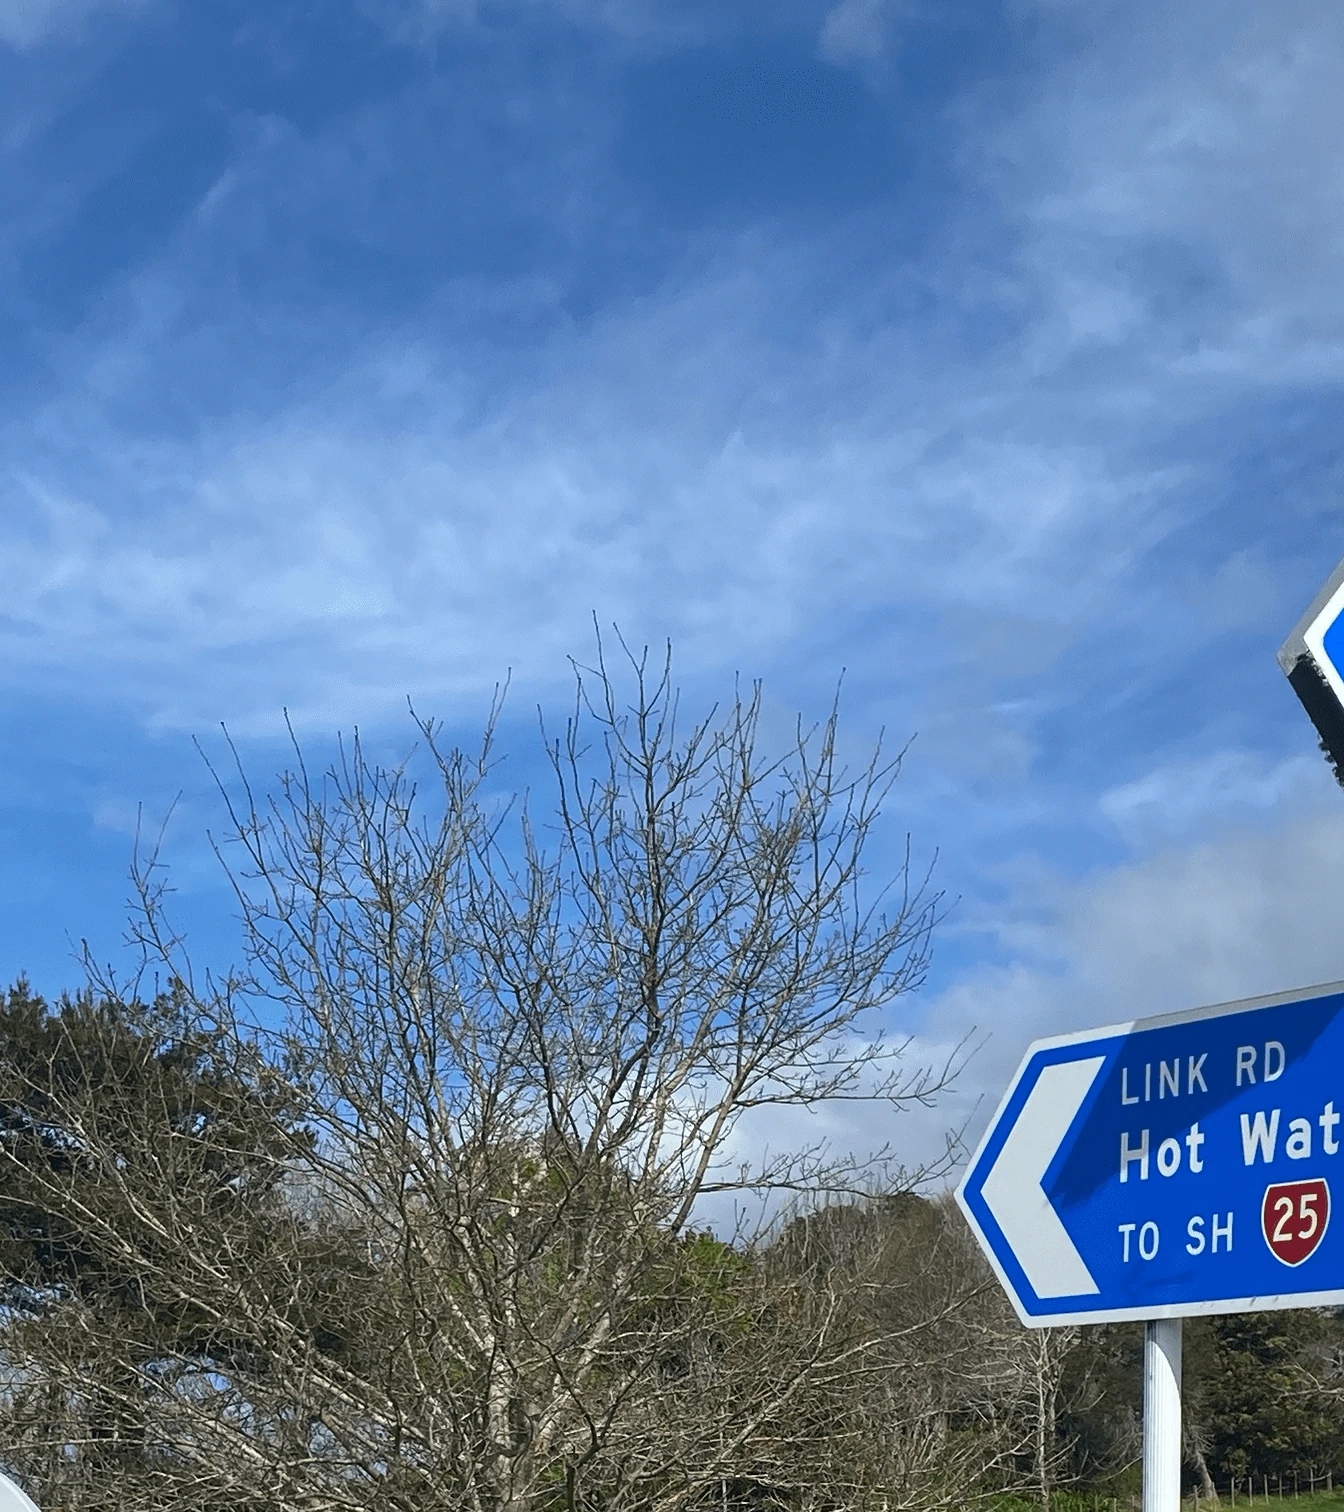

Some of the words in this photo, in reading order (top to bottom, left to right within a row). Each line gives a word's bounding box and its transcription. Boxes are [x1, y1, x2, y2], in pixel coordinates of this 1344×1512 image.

[1122, 1053, 1208, 1105] LINK
[1236, 1041, 1285, 1086] RD
[1119, 1123, 1205, 1183] Hot
[1118, 1221, 1159, 1263] TO
[1185, 1212, 1234, 1256] SH
[1272, 1193, 1319, 1243] 25
